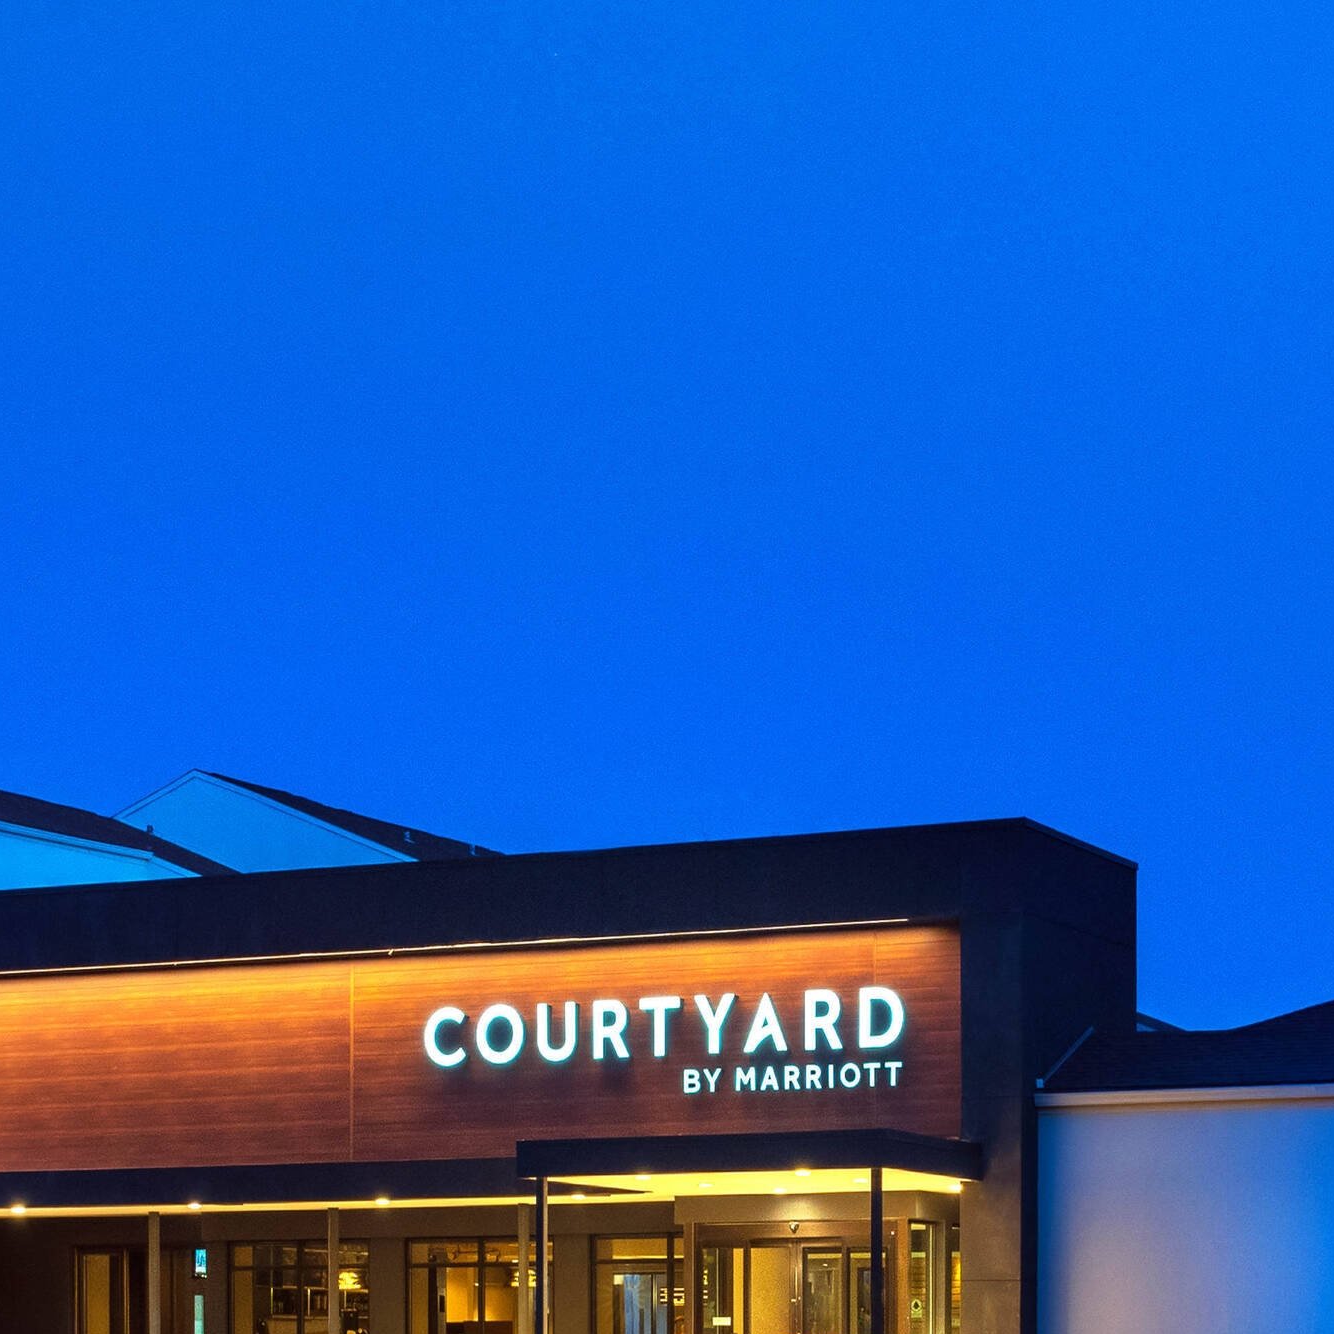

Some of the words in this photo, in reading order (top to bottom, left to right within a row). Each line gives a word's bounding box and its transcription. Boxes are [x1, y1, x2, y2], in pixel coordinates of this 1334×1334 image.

[423, 985, 905, 1067] COURTYARD
[682, 1067, 722, 1094] BY
[734, 1060, 903, 1092] MARRIOTT
